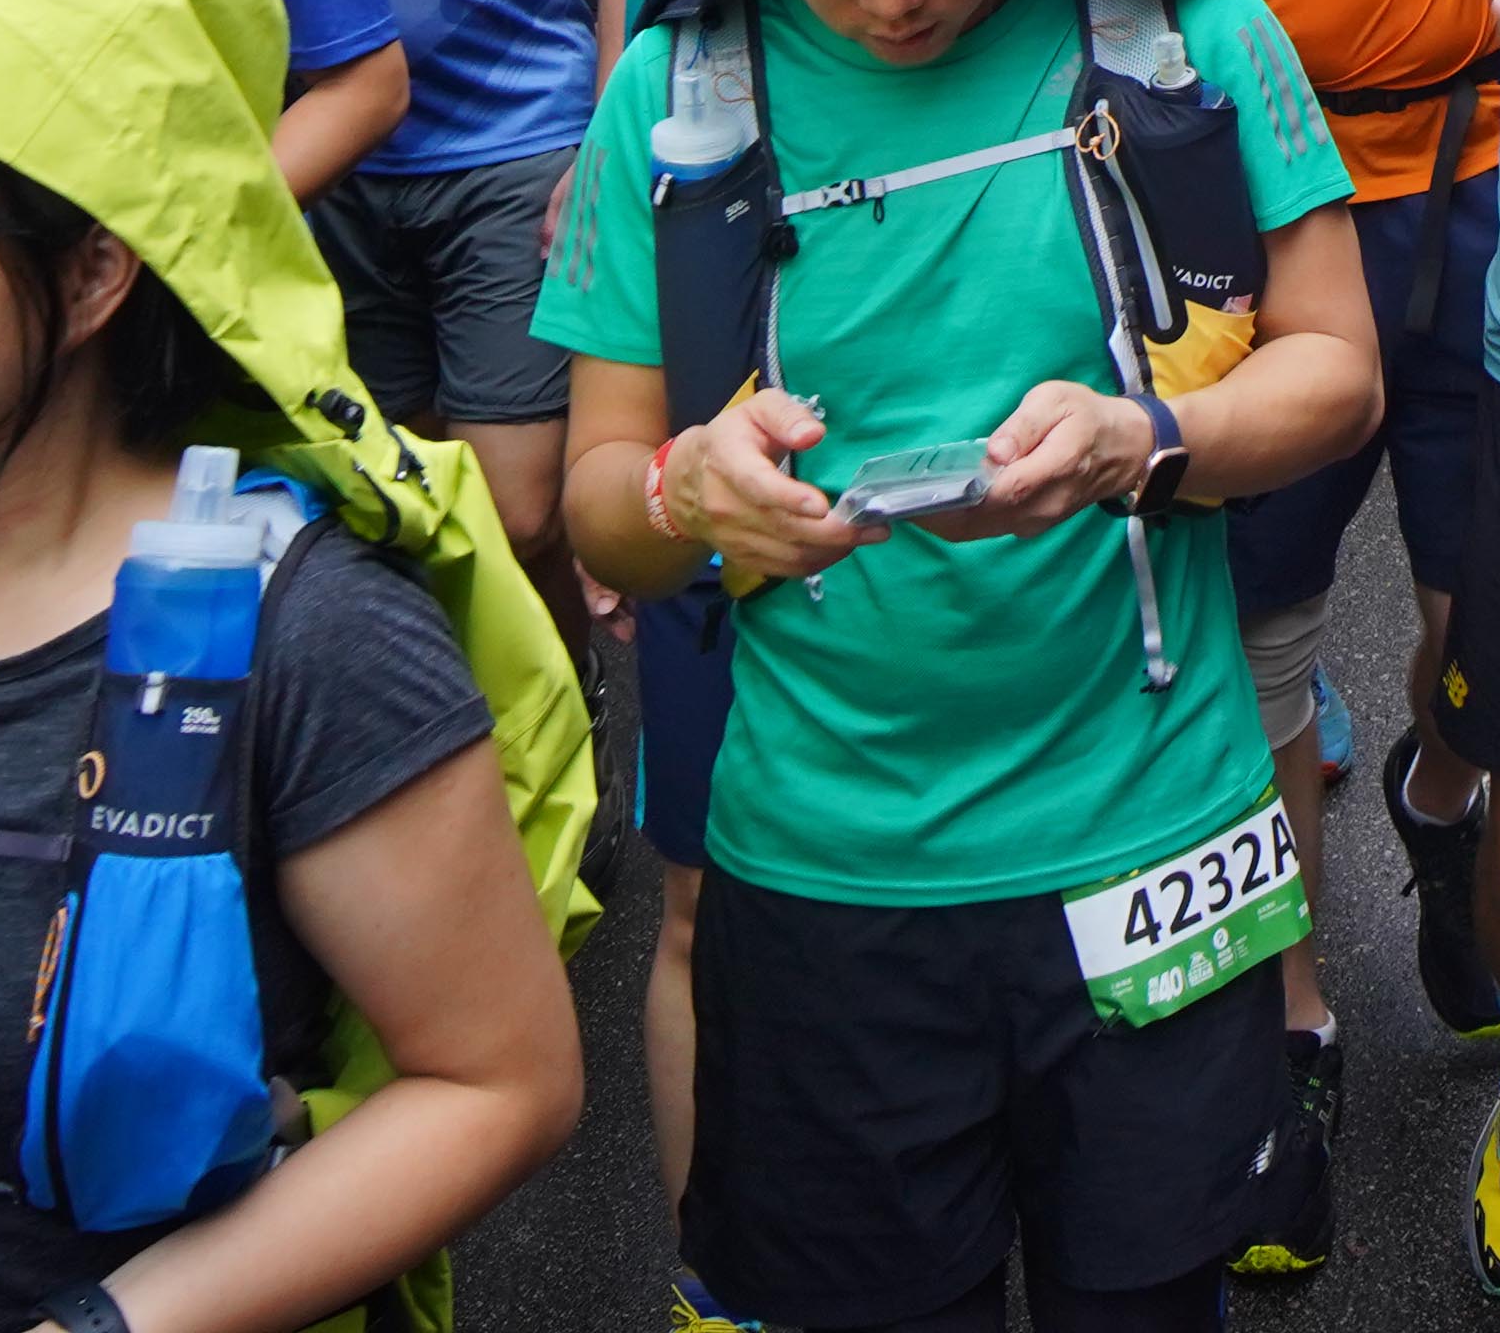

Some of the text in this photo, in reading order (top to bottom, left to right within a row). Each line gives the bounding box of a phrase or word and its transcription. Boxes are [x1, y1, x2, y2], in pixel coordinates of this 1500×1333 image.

[1172, 265, 1234, 290] VADICT
[91, 805, 215, 839] EVADICT
[1124, 810, 1299, 947] 4232A
